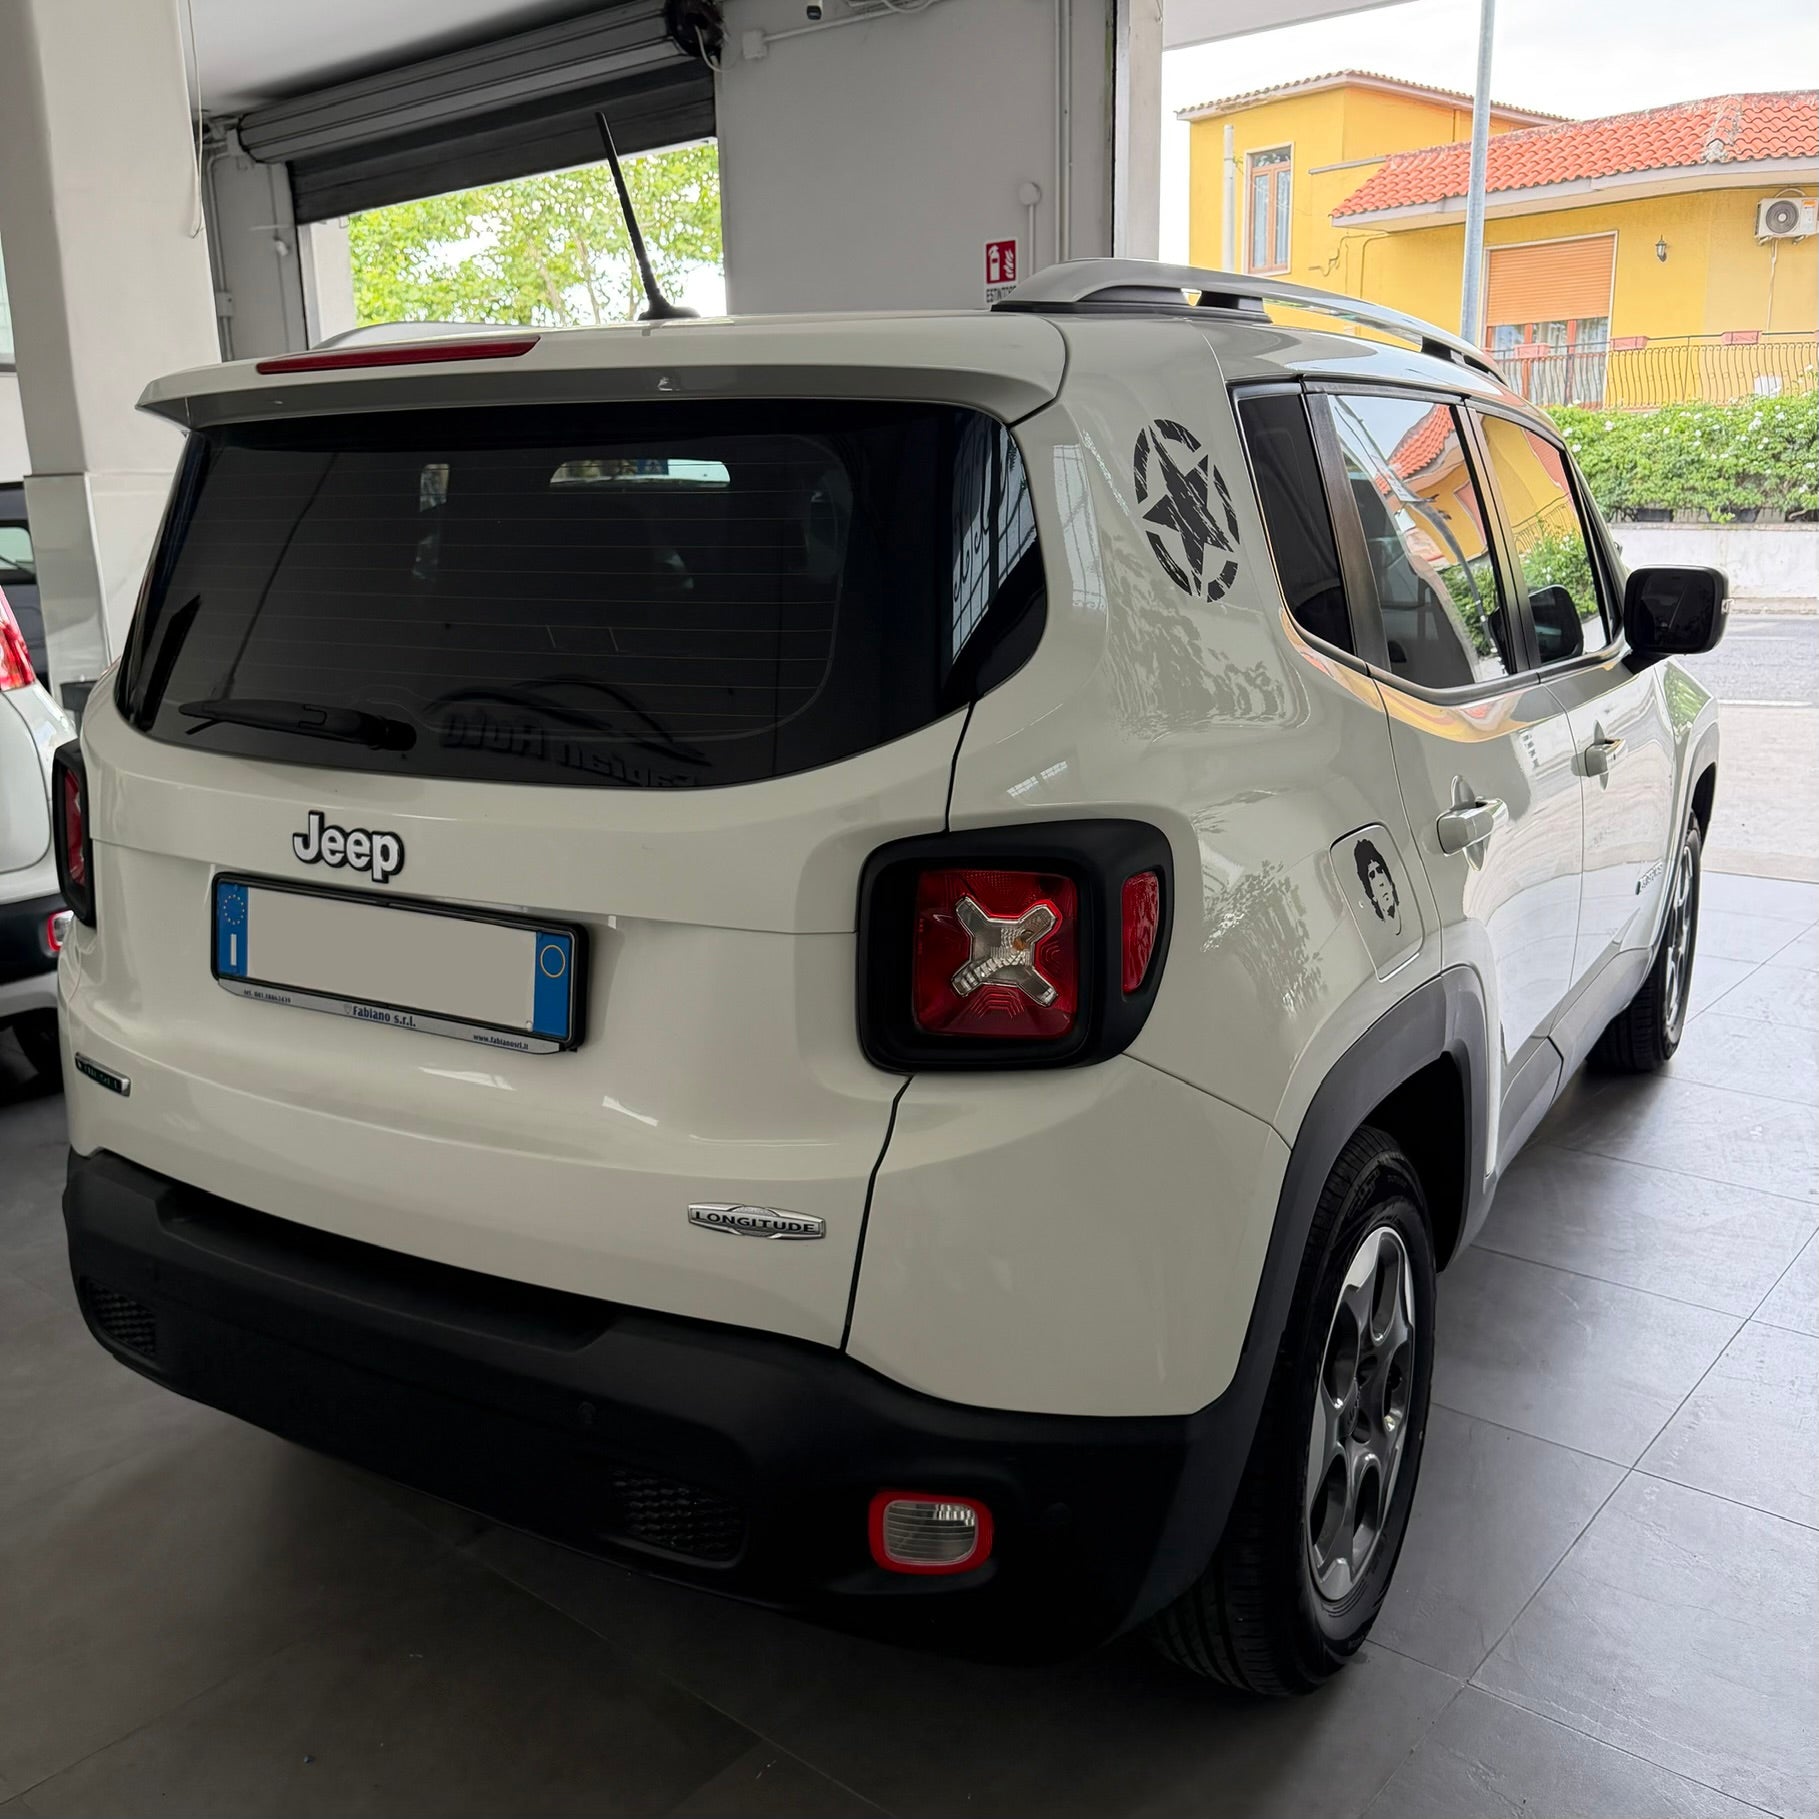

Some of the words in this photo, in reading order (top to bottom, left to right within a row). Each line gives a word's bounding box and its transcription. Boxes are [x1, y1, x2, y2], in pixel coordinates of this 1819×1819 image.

[293, 810, 404, 883] Jeep
[353, 1005, 390, 1022] Fabiano
[394, 1014, 416, 1027] s.r.l.
[695, 1211, 816, 1233] LONGITUDE
